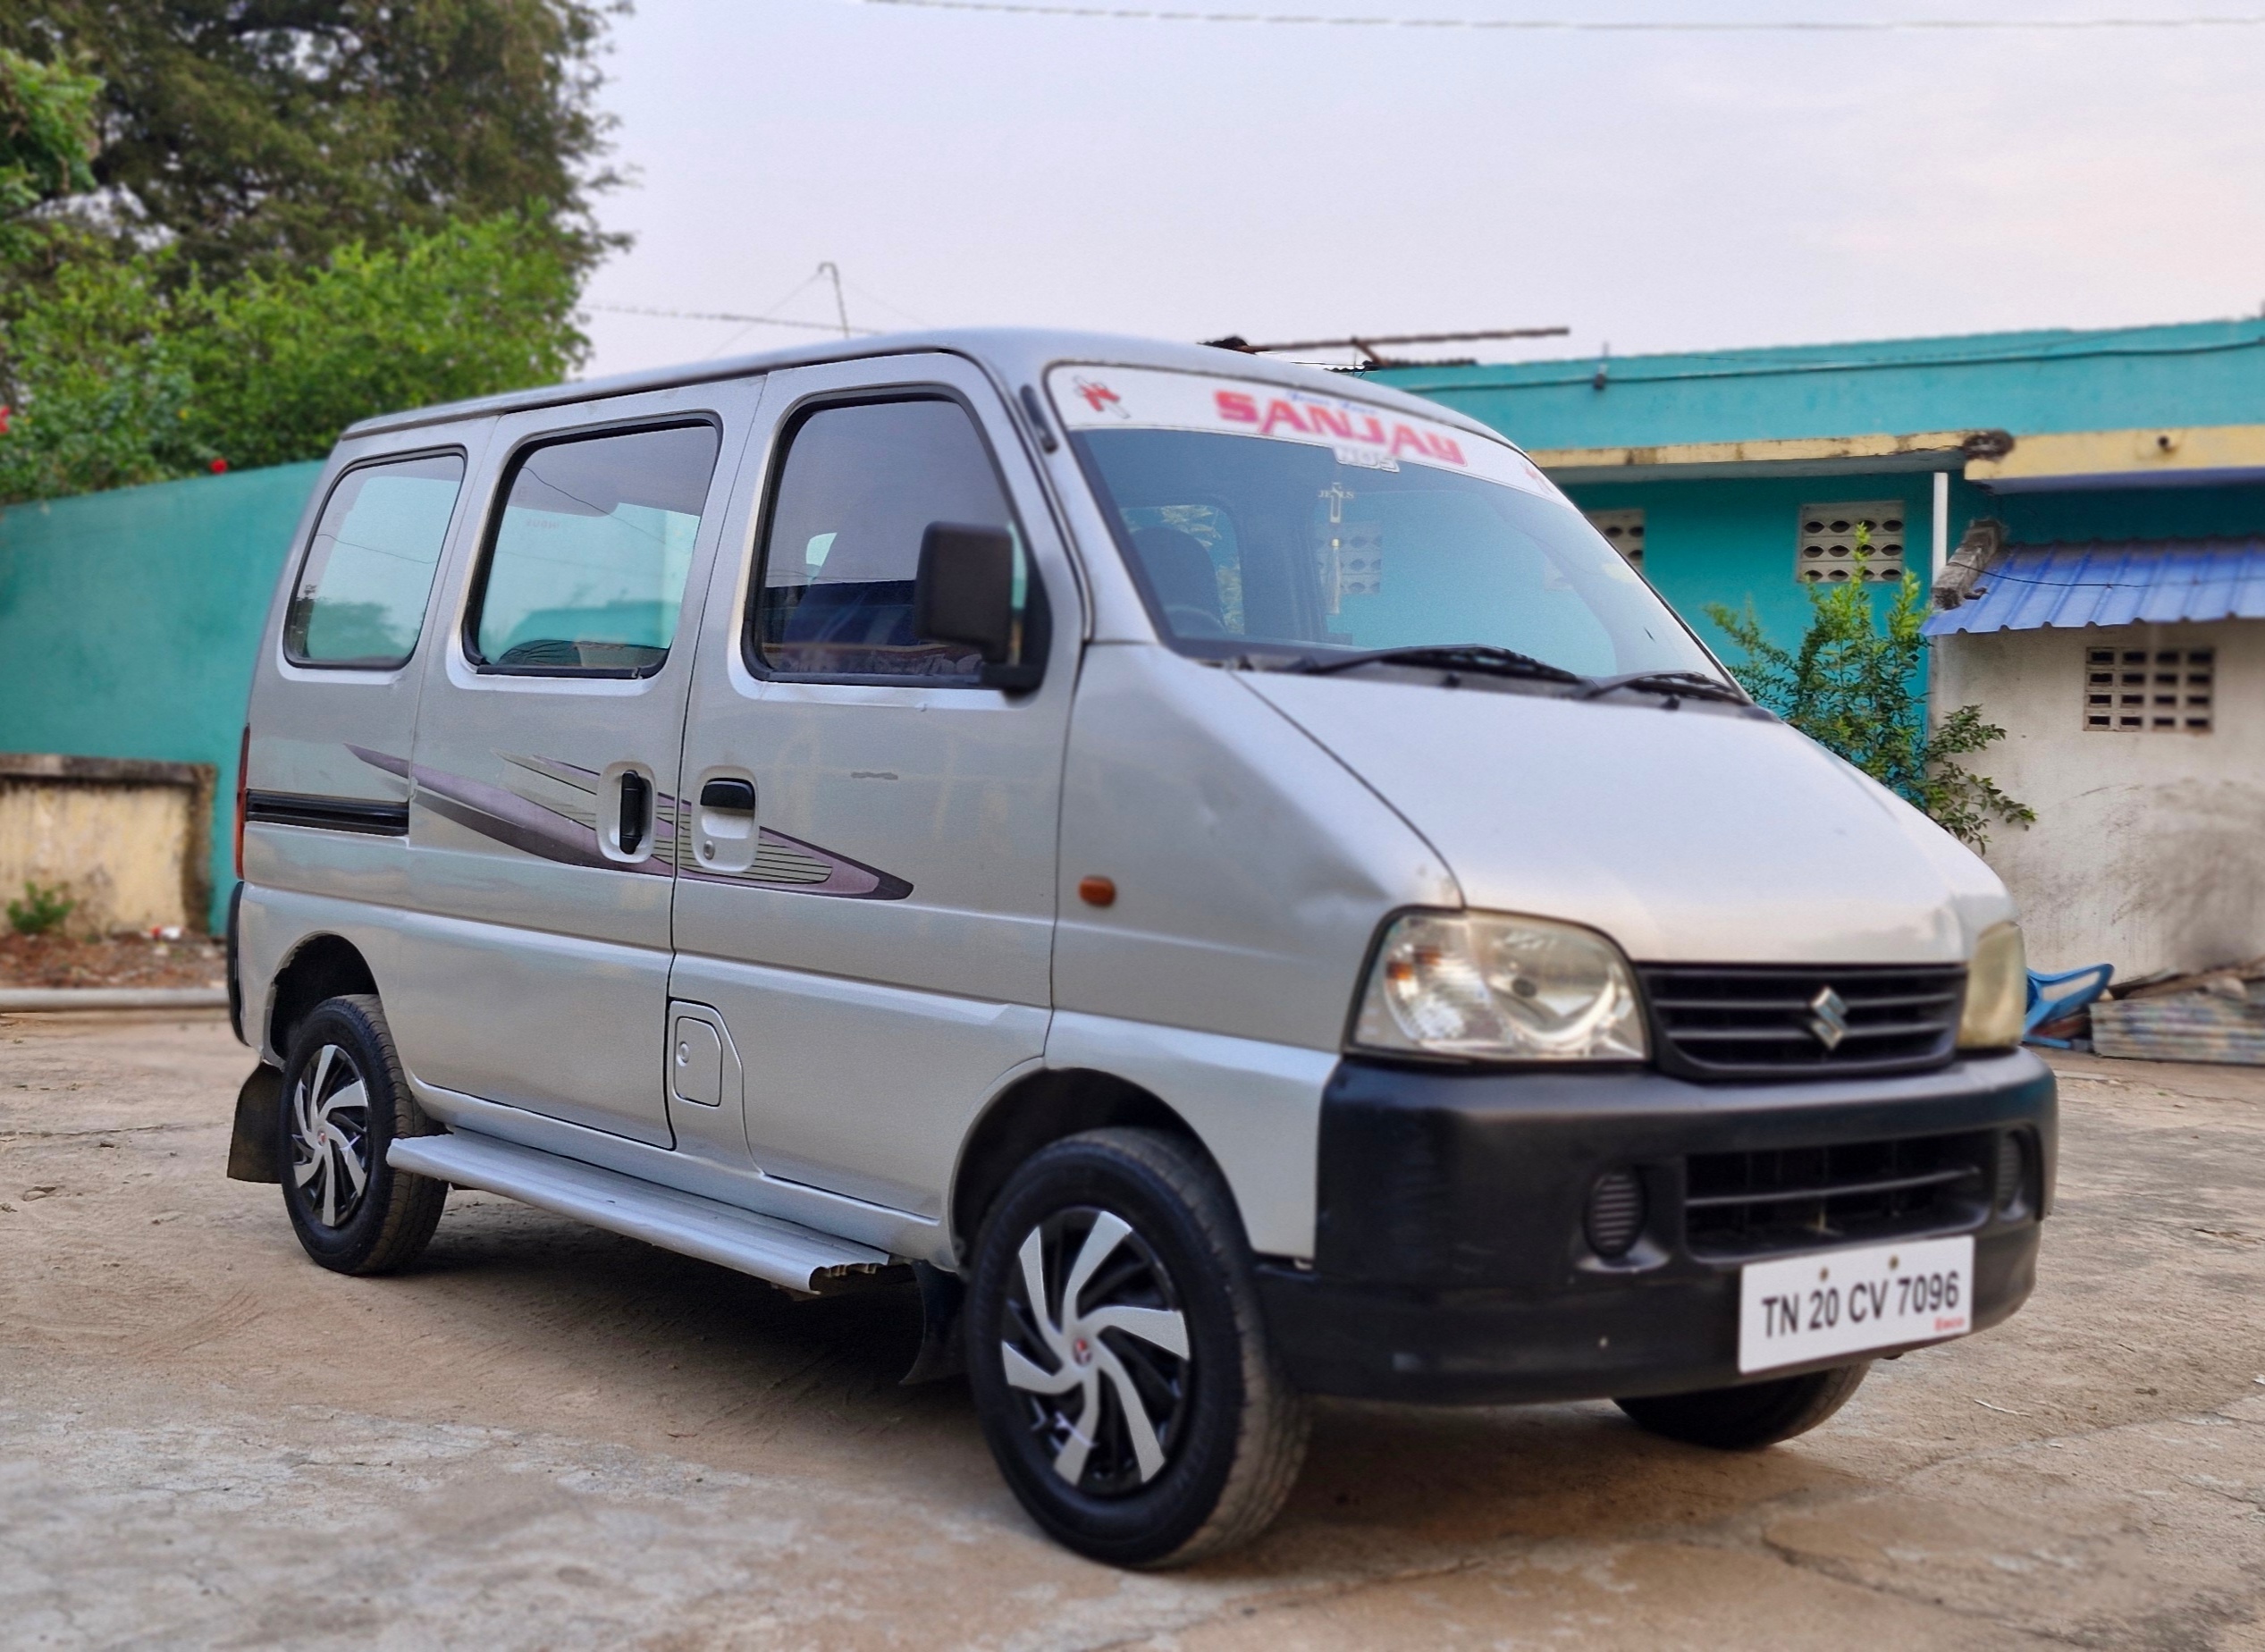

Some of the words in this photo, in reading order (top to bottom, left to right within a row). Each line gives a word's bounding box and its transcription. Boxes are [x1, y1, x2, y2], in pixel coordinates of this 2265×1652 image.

[1762, 1293, 1799, 1338] TN
[1808, 1287, 1840, 1330] 20
[1848, 1278, 1889, 1323] CV
[1897, 1270, 1959, 1316] 7096
